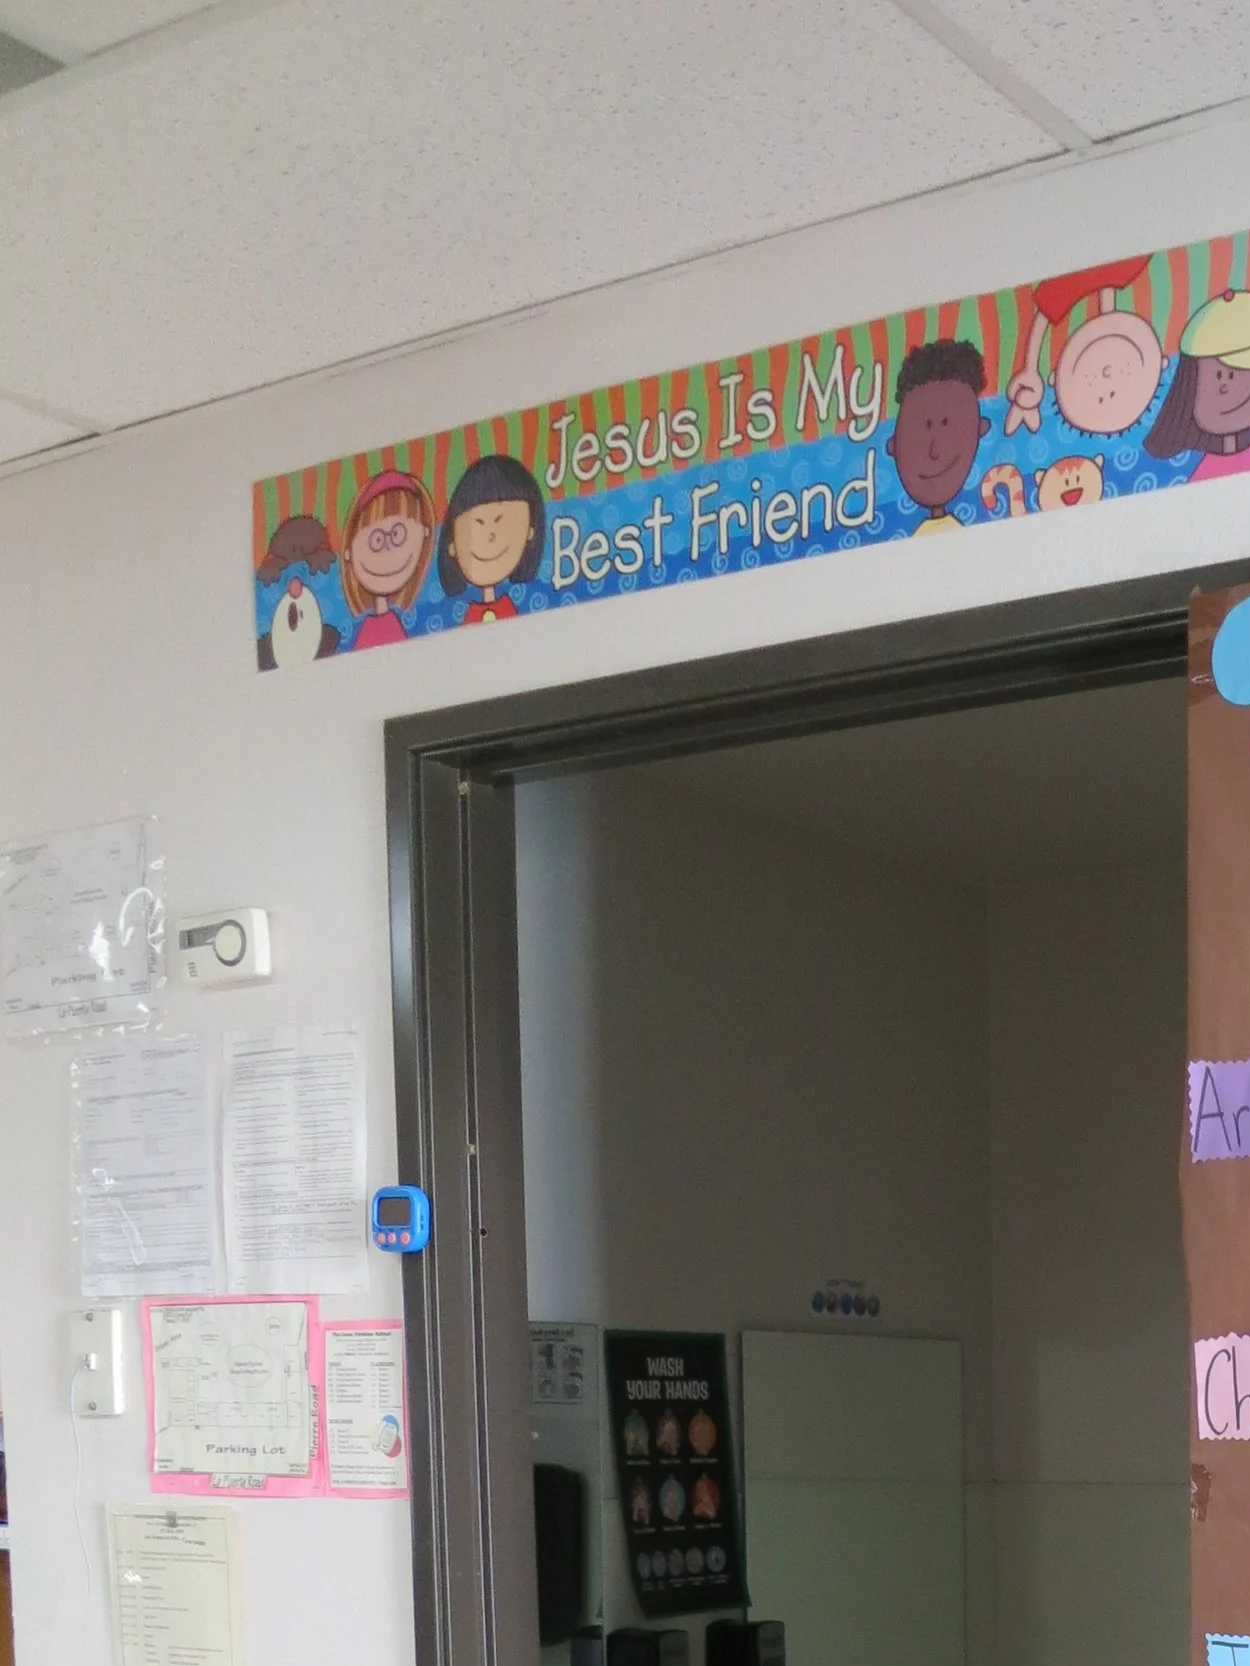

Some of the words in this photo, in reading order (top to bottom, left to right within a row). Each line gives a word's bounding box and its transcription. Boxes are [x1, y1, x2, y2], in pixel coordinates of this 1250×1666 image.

[545, 408, 702, 489] Jesus
[719, 373, 777, 449] Is
[796, 345, 882, 442] My
[552, 496, 674, 591] Best
[690, 448, 876, 561] Friend
[647, 1358, 684, 1377] WASH
[625, 1381, 661, 1400] YOUR
[665, 1381, 709, 1400] HANDS
[206, 1443, 257, 1456] Parking
[262, 1444, 286, 1455] Lot
